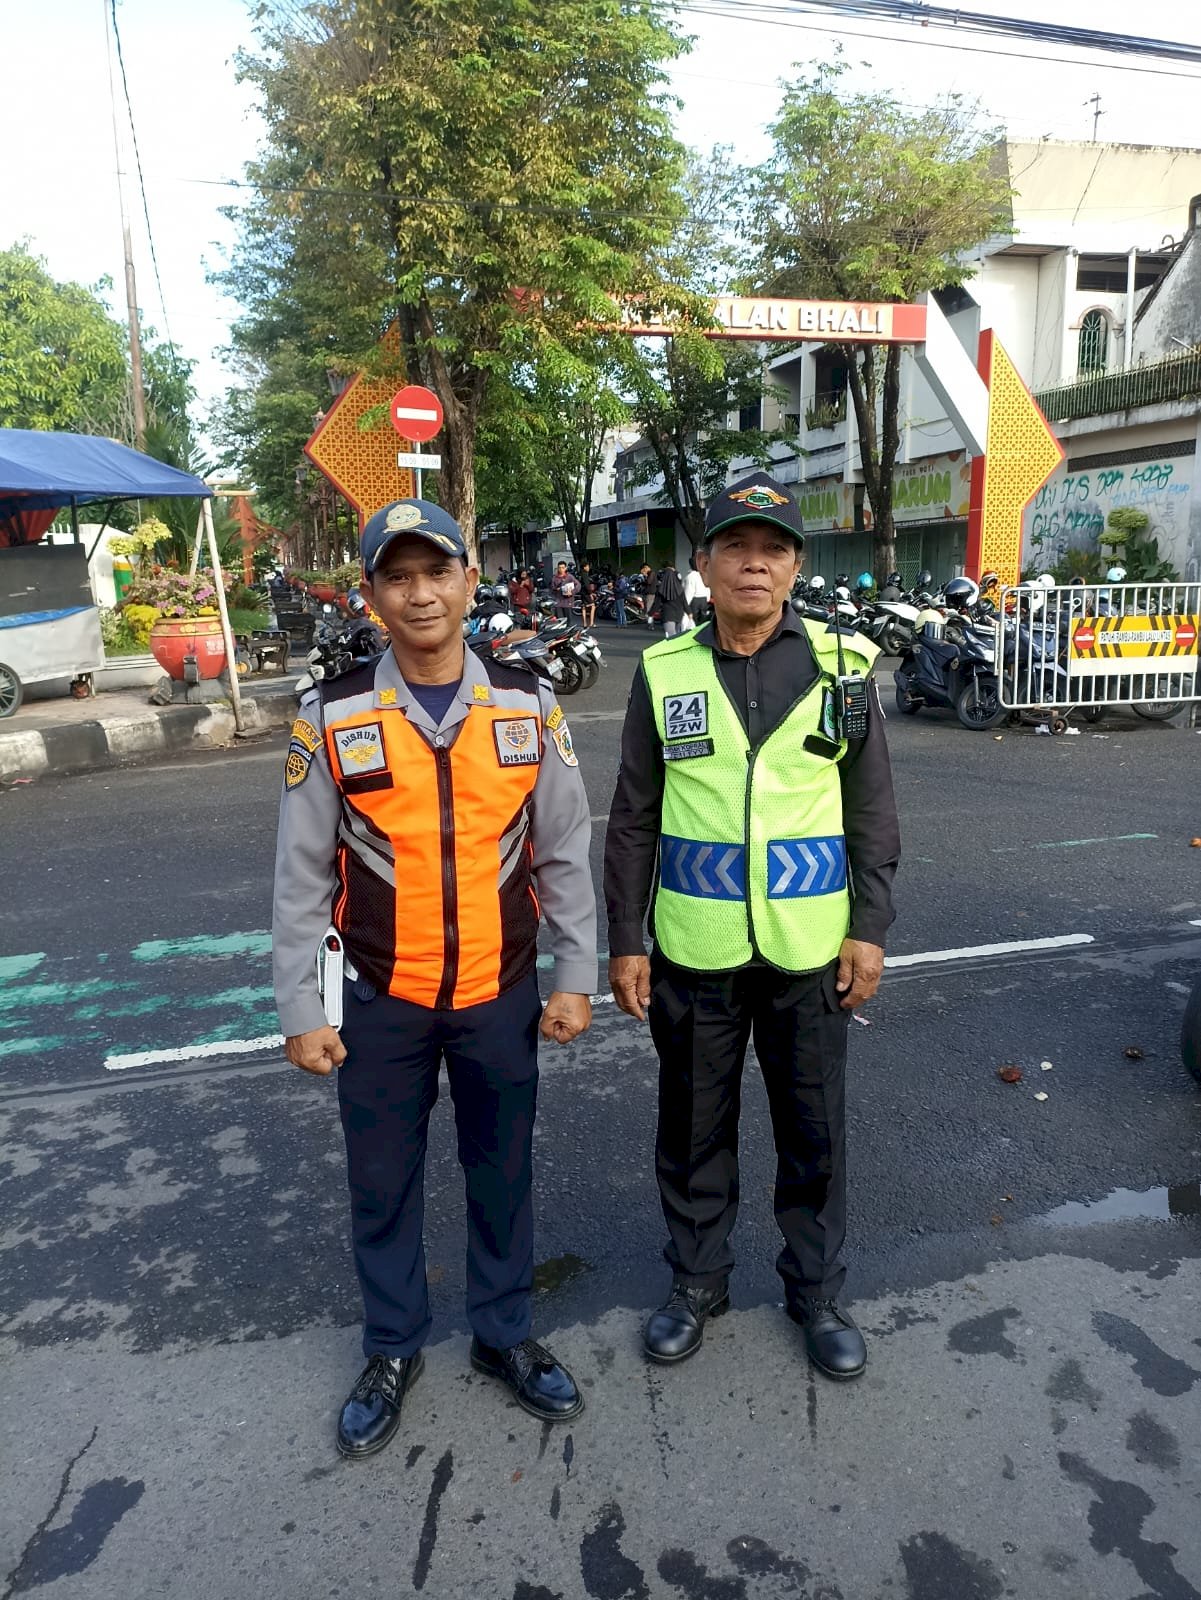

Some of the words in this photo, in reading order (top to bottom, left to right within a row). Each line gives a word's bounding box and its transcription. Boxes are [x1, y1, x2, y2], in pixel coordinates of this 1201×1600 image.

[712, 304, 788, 330] ALAN
[799, 307, 884, 334] BHALI
[669, 697, 702, 721] 24
[670, 721, 702, 734] ZZW
[341, 730, 377, 748] DISHUB
[503, 752, 537, 763] DISHUB
